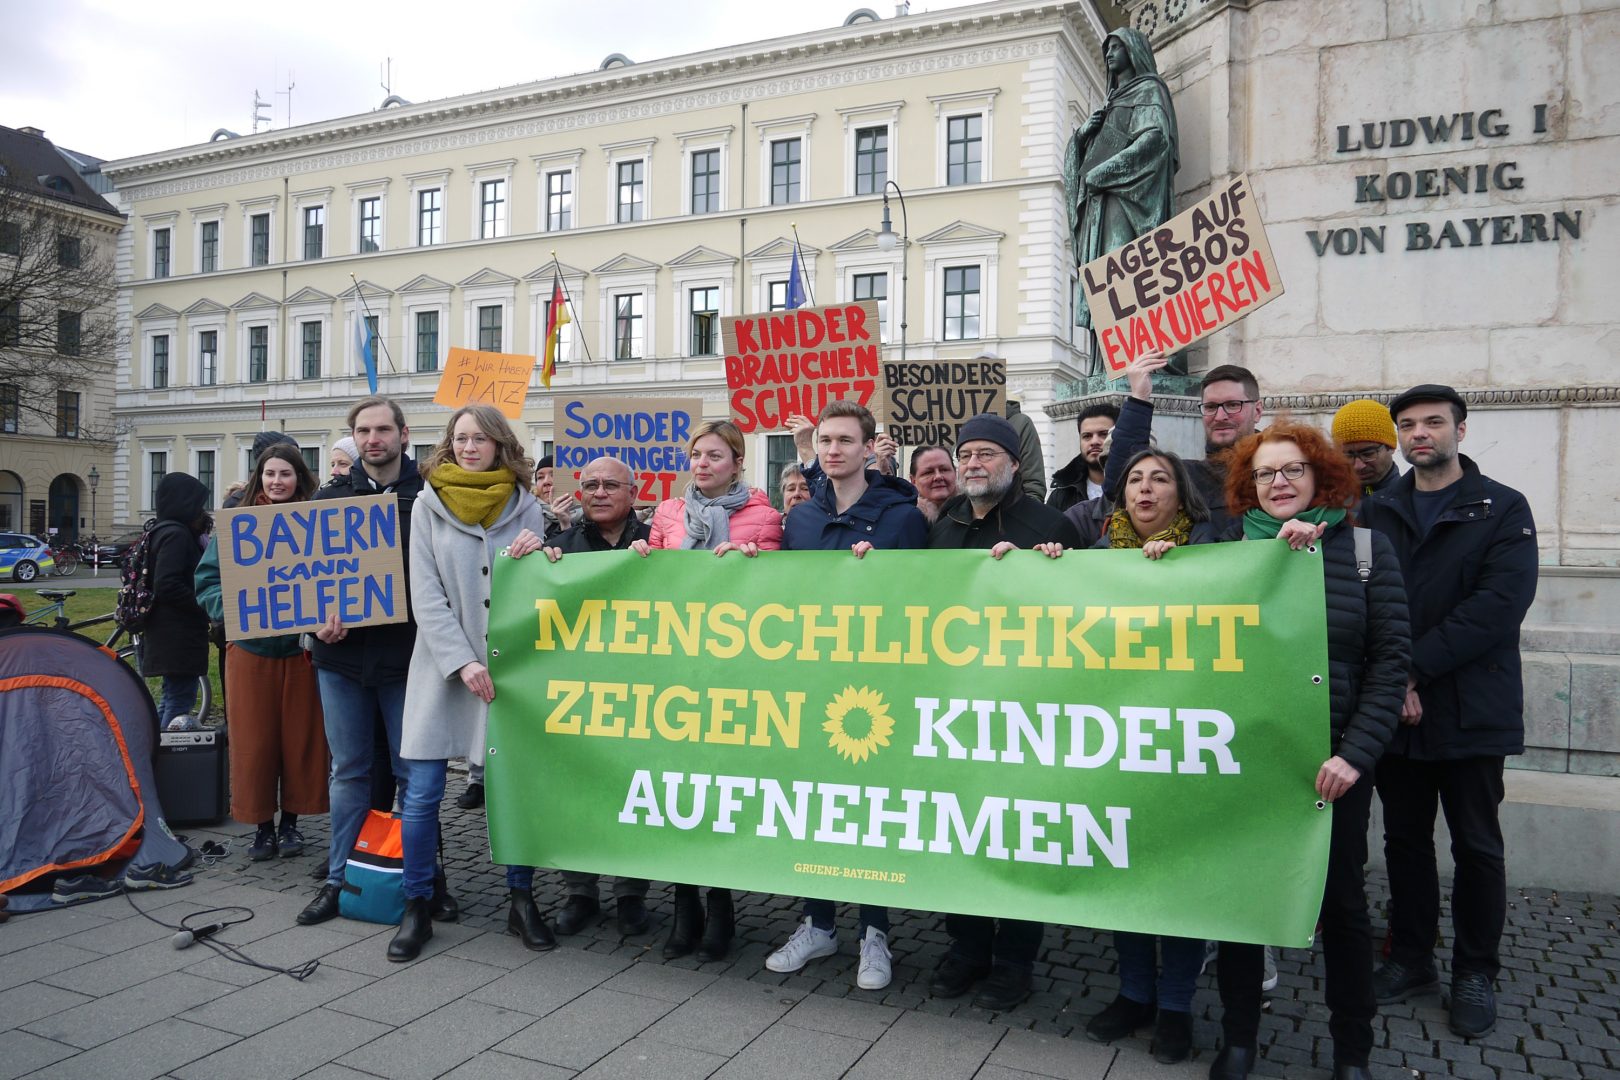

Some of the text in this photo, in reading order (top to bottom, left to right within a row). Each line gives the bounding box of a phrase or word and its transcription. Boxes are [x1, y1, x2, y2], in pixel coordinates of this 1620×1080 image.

[1336, 103, 1548, 153] LUDWIG I
[1354, 161, 1524, 203] KOENIG
[1084, 180, 1246, 295] LAGER AUF
[1305, 210, 1583, 258] VON BAYERN
[1108, 218, 1250, 321] LESBOS
[735, 305, 871, 355] KINDER
[1101, 250, 1271, 371] EVAKUIEREN
[455, 372, 526, 405] PLATZ
[725, 345, 880, 390] BRAUCHEN
[883, 362, 1007, 389] BESONDERS
[564, 401, 691, 443] SONDER
[890, 388, 998, 423] SCHUTZ
[231, 503, 396, 566] BAYERN
[267, 557, 360, 584] KANN
[238, 573, 394, 632] HELFEN
[534, 598, 1260, 672] MENSCHLICHKEIT
[545, 679, 1241, 775] ZEIGEN KINDER
[618, 769, 1131, 869] AUFNEHMEN
[793, 862, 906, 883] GRUENE-BAYERN.DE
